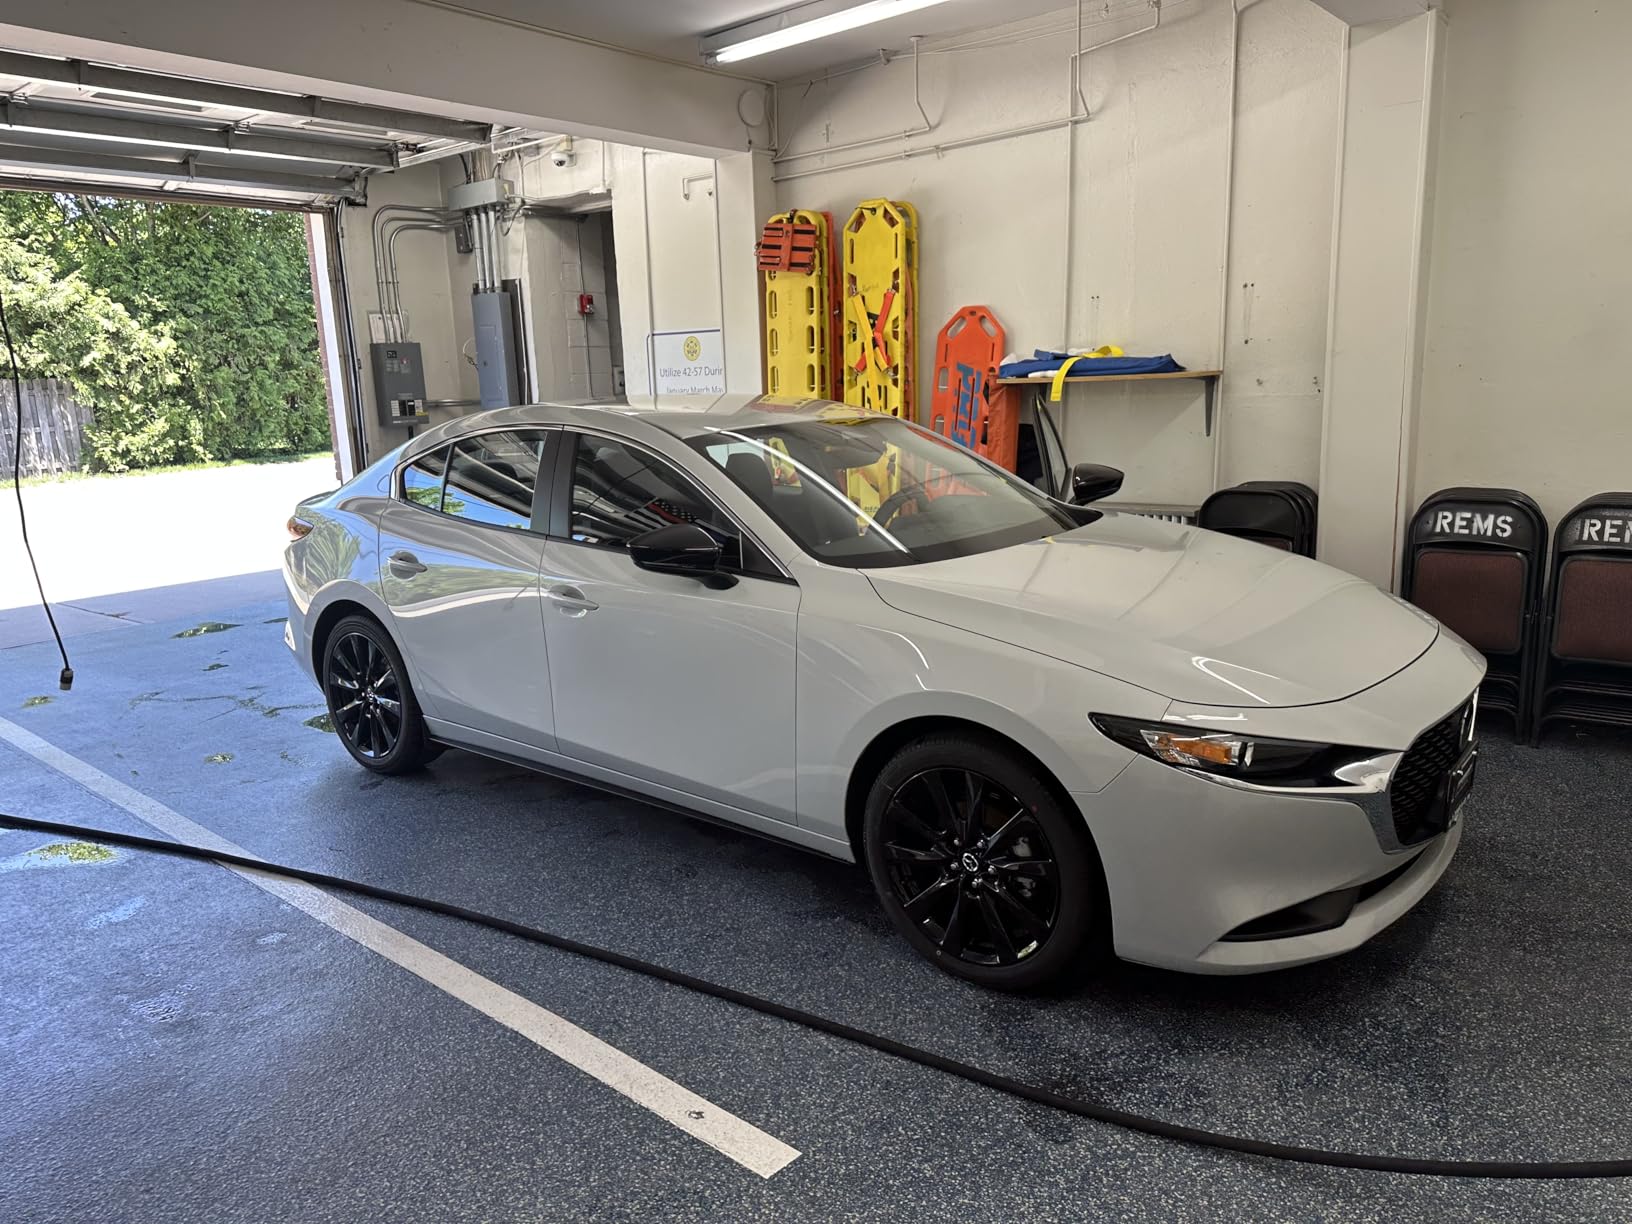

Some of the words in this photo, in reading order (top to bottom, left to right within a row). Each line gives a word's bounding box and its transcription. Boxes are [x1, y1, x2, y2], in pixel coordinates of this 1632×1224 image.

[659, 367, 681, 378] Utilize
[682, 366, 703, 377] 42-57
[1434, 511, 1513, 538] REMS
